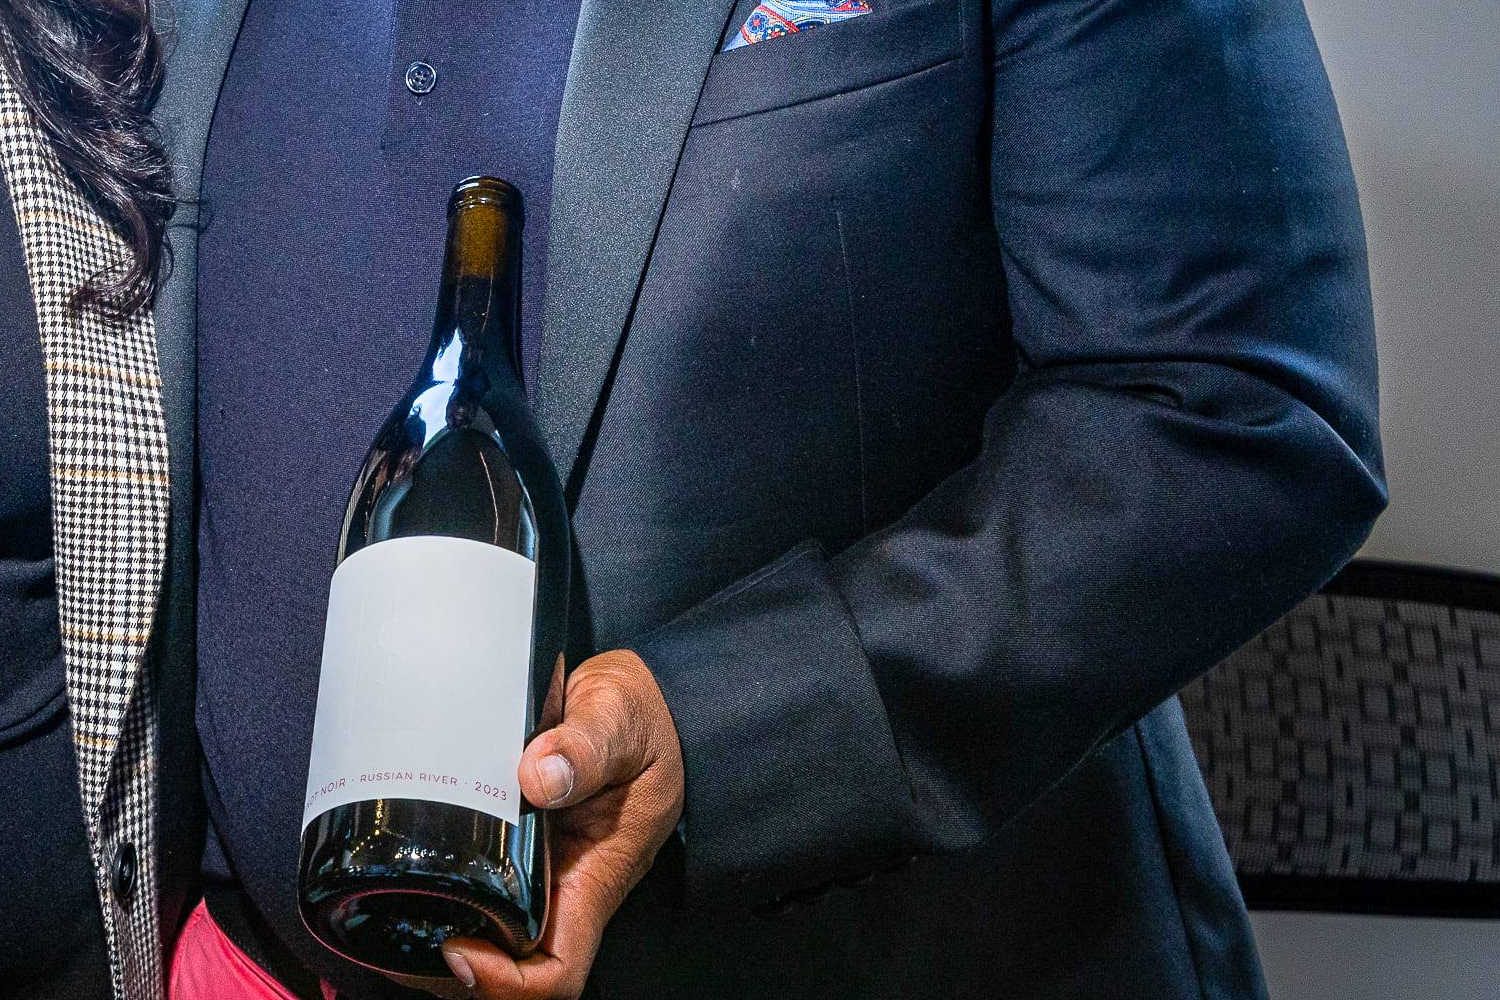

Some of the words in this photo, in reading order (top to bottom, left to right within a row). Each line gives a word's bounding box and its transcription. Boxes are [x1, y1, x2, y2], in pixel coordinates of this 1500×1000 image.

[320, 777, 347, 798] NOIR
[360, 771, 413, 783] RUSSIAN
[419, 772, 458, 786] RIVER
[474, 781, 507, 801] 2023
